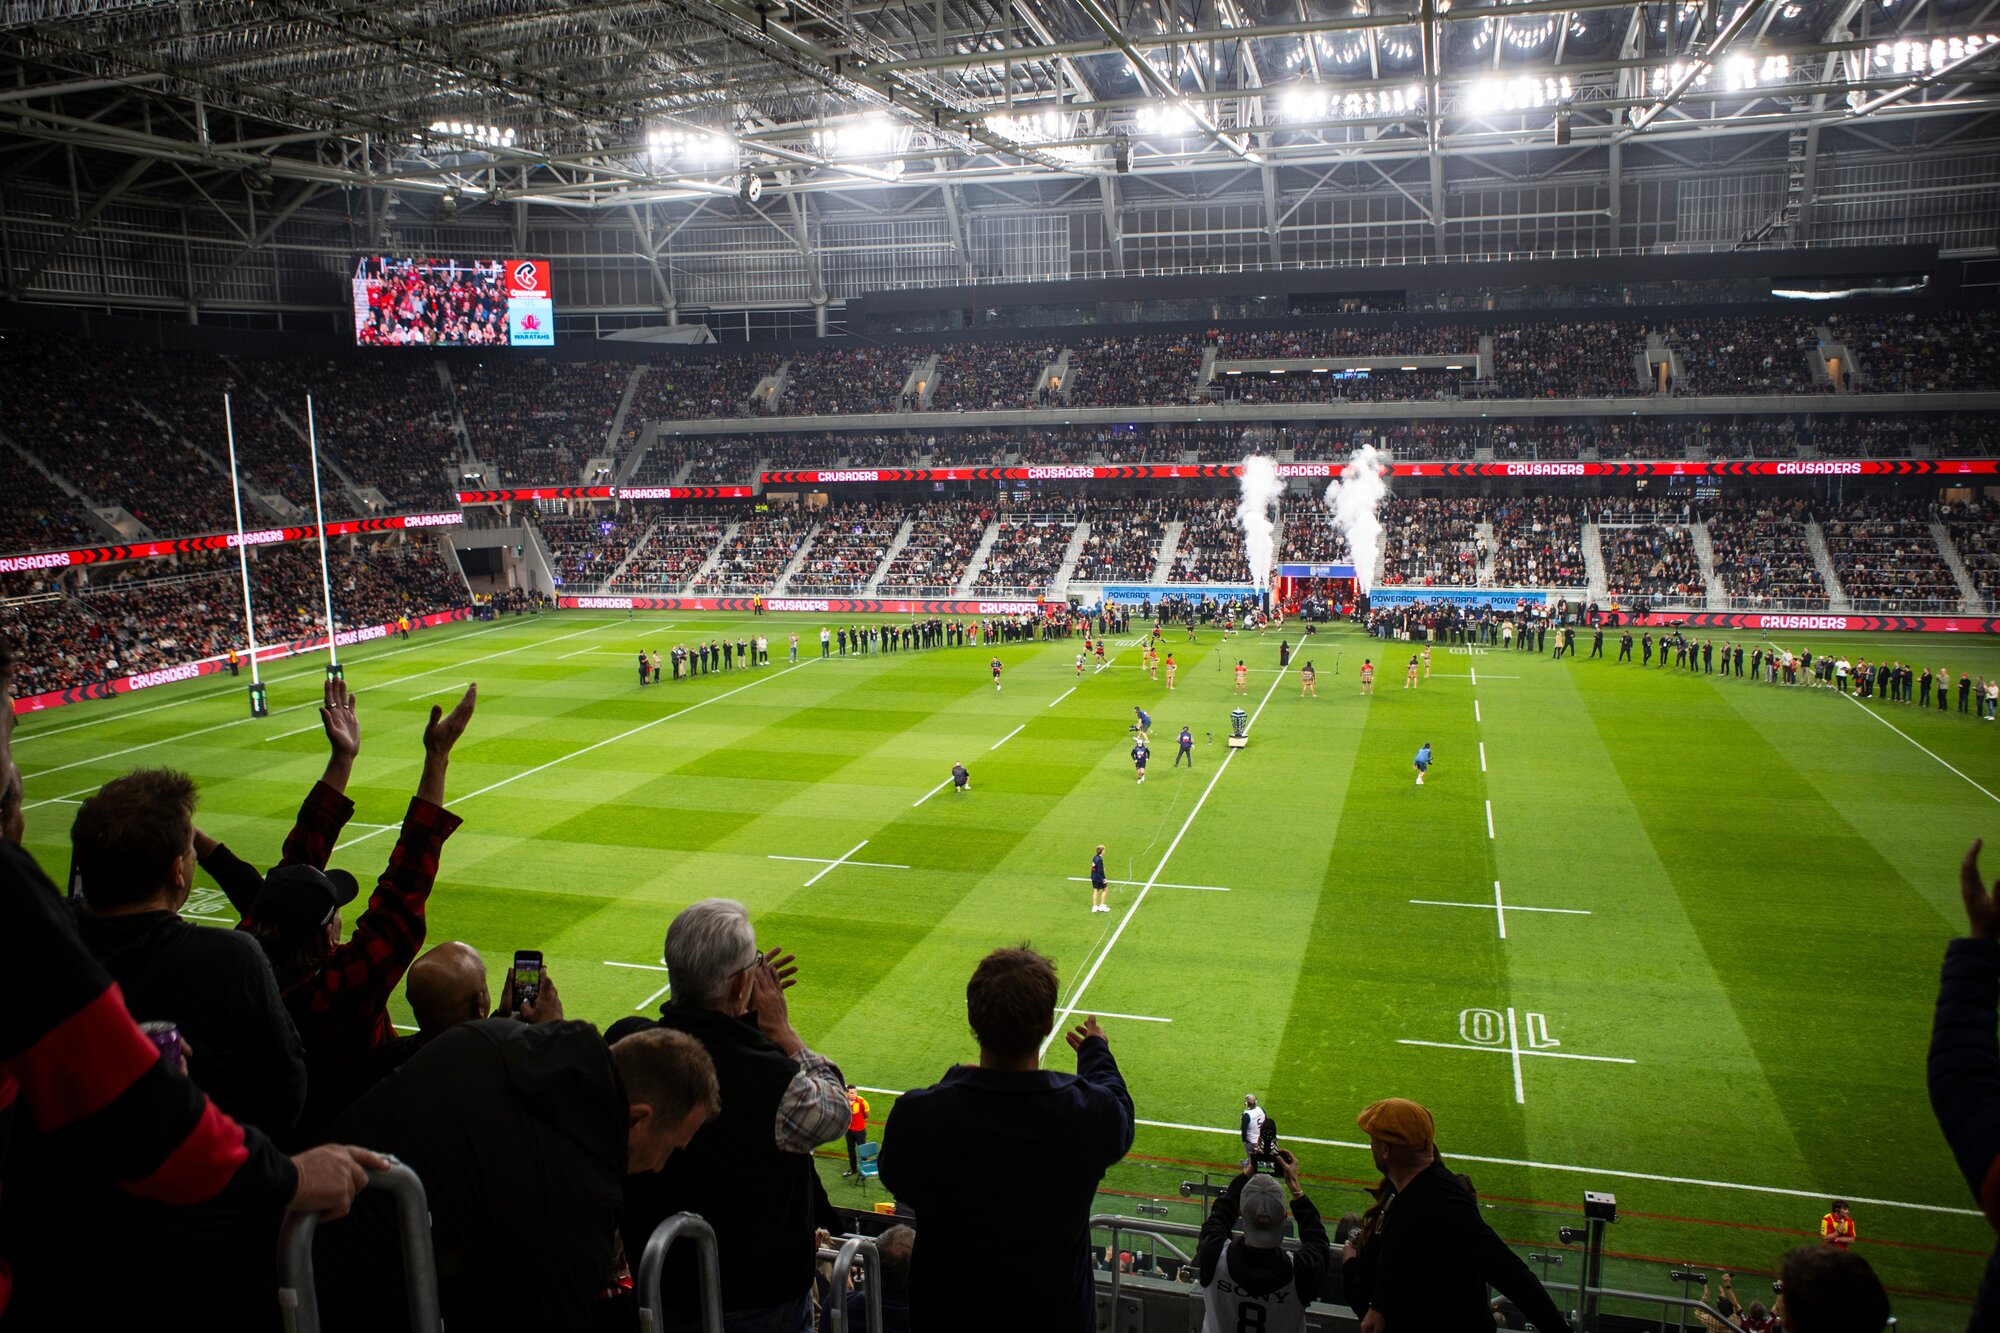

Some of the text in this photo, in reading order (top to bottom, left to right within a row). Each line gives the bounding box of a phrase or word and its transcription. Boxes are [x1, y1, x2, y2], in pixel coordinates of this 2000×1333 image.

[1028, 468, 1094, 479] CRUSADERS
[1274, 465, 1330, 476] USADERS
[1507, 464, 1584, 476] CRUSADERS
[1777, 462, 1861, 474] CRUSADERS
[818, 471, 878, 482] CRUSADERS
[227, 530, 284, 547] CRUSADERS
[0, 552, 70, 572] RUSADERS
[1162, 592, 1204, 600] POWRAD
[1372, 595, 1417, 603] POWERADE
[578, 597, 632, 609] CRUSADERS
[768, 600, 829, 611] CRUSADERS
[979, 602, 1039, 614] CRUSADER
[1760, 615, 1847, 629] CRUSADERS
[335, 625, 386, 646] CRUSADERS
[129, 664, 199, 690] CRUSADERS
[1237, 1301, 1267, 1333] 8
